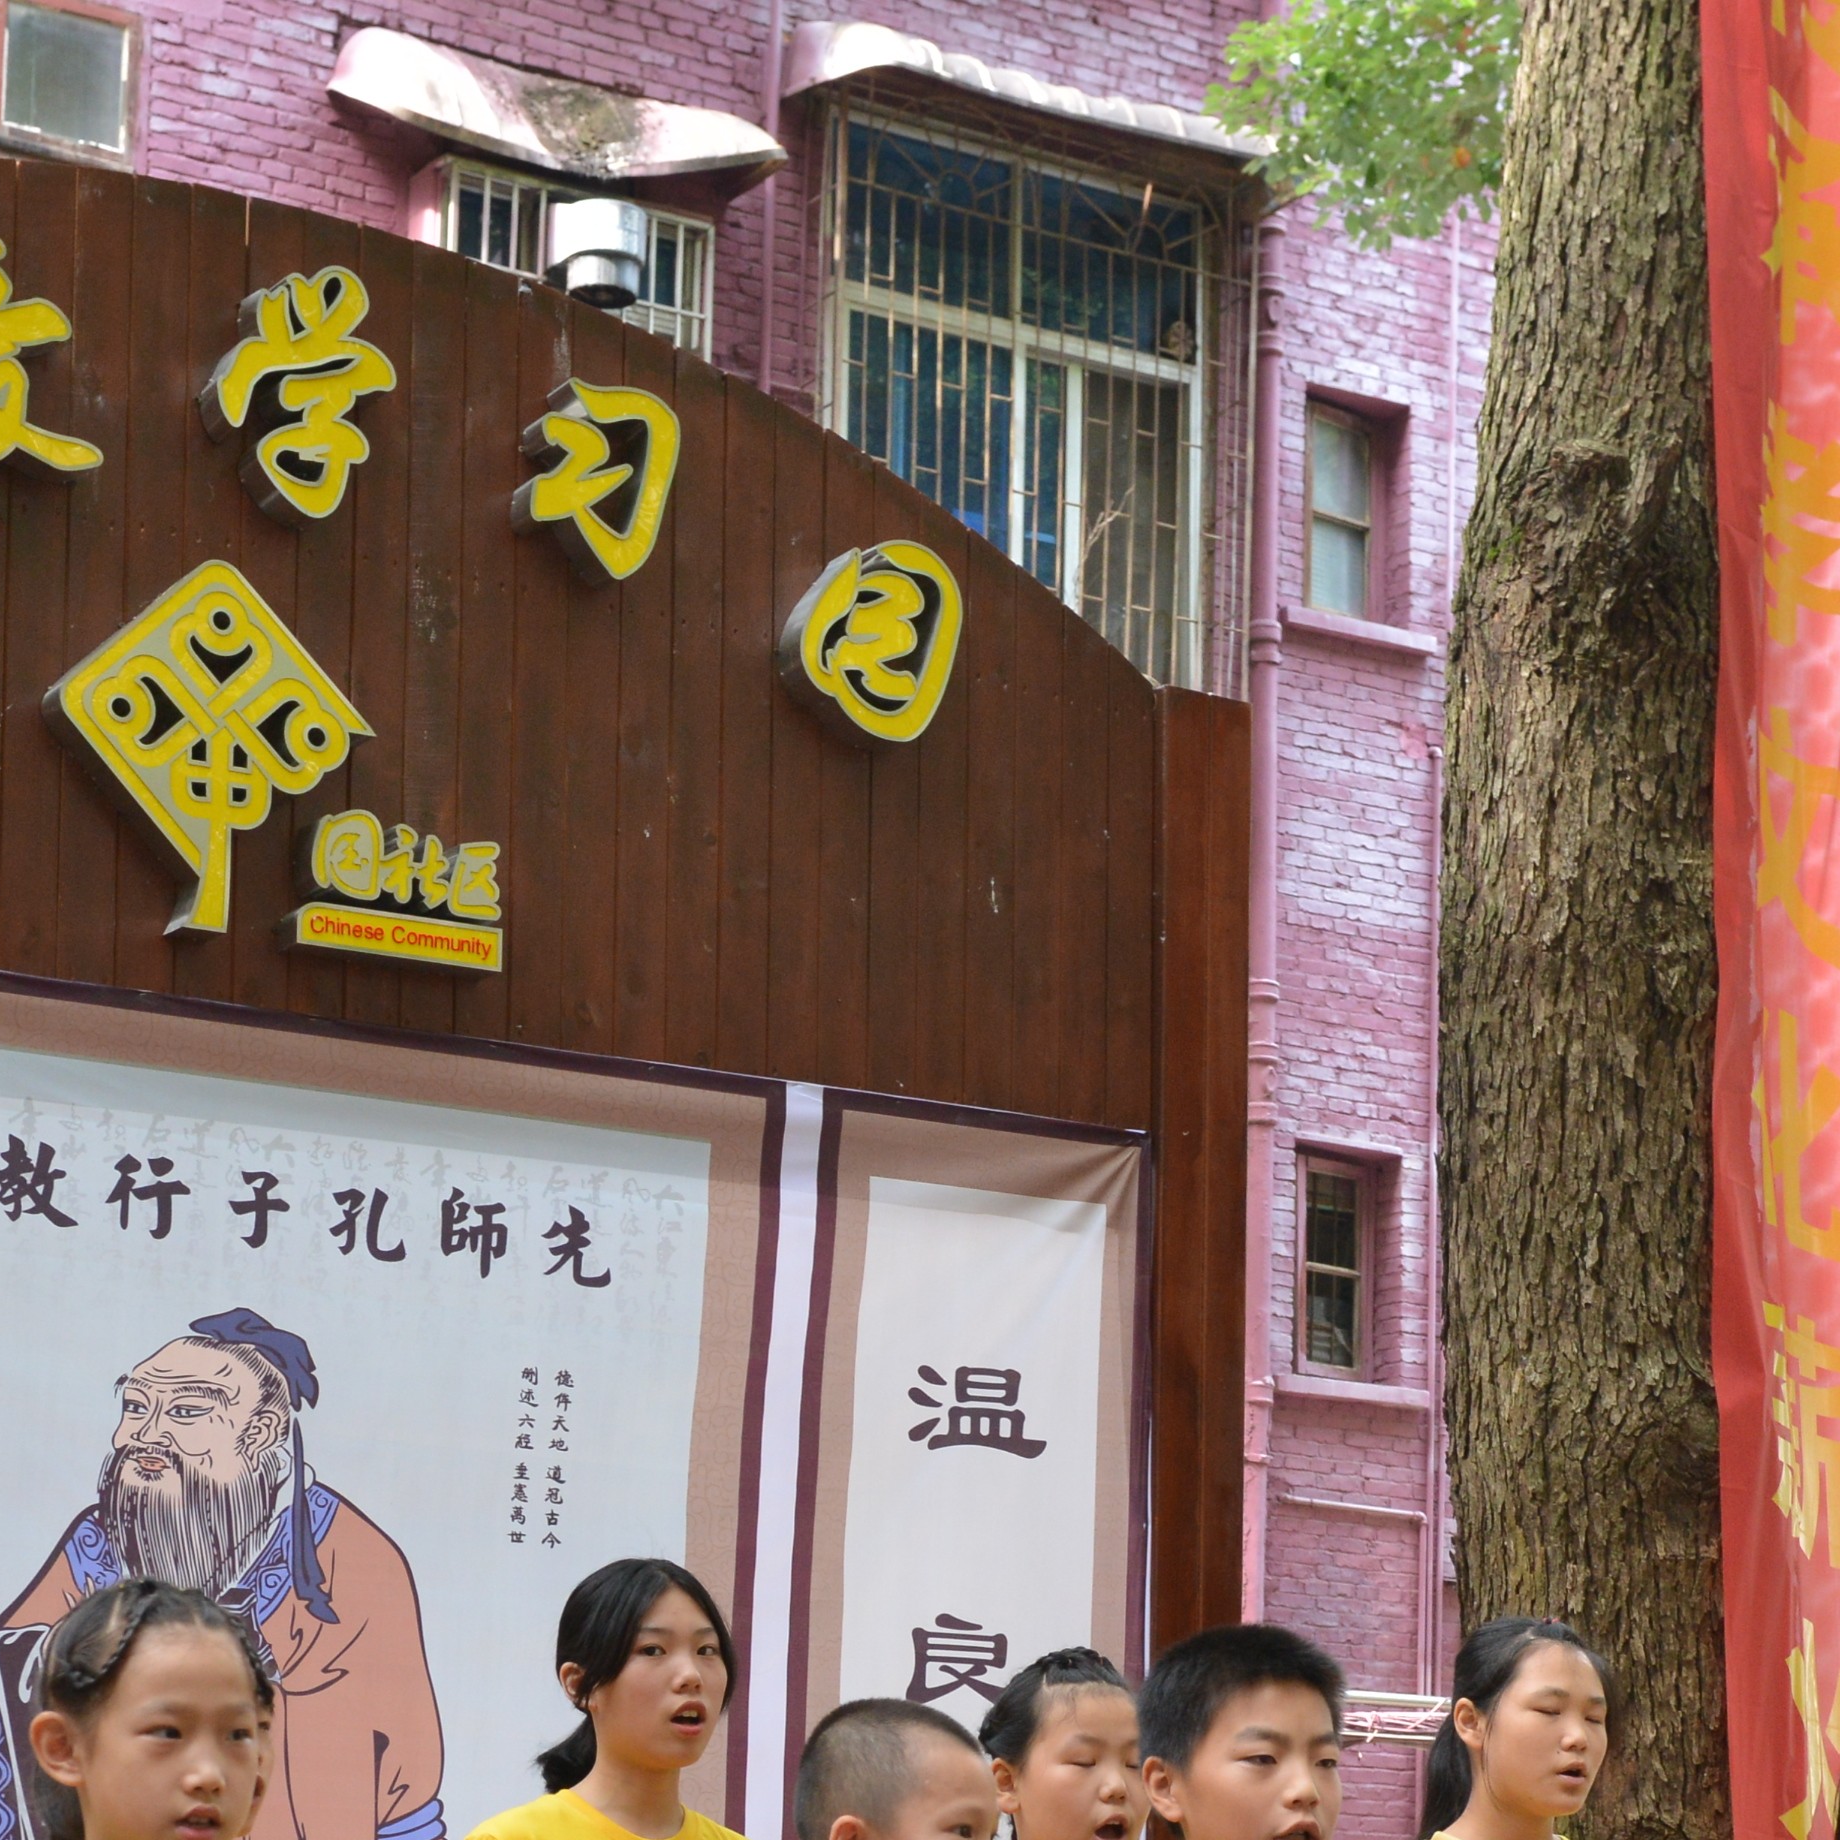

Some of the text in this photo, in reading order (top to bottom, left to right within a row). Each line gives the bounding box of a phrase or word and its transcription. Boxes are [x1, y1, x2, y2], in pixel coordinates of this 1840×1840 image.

[310, 916, 492, 960] Chinese Community
[907, 1364, 1047, 1704] 温良
